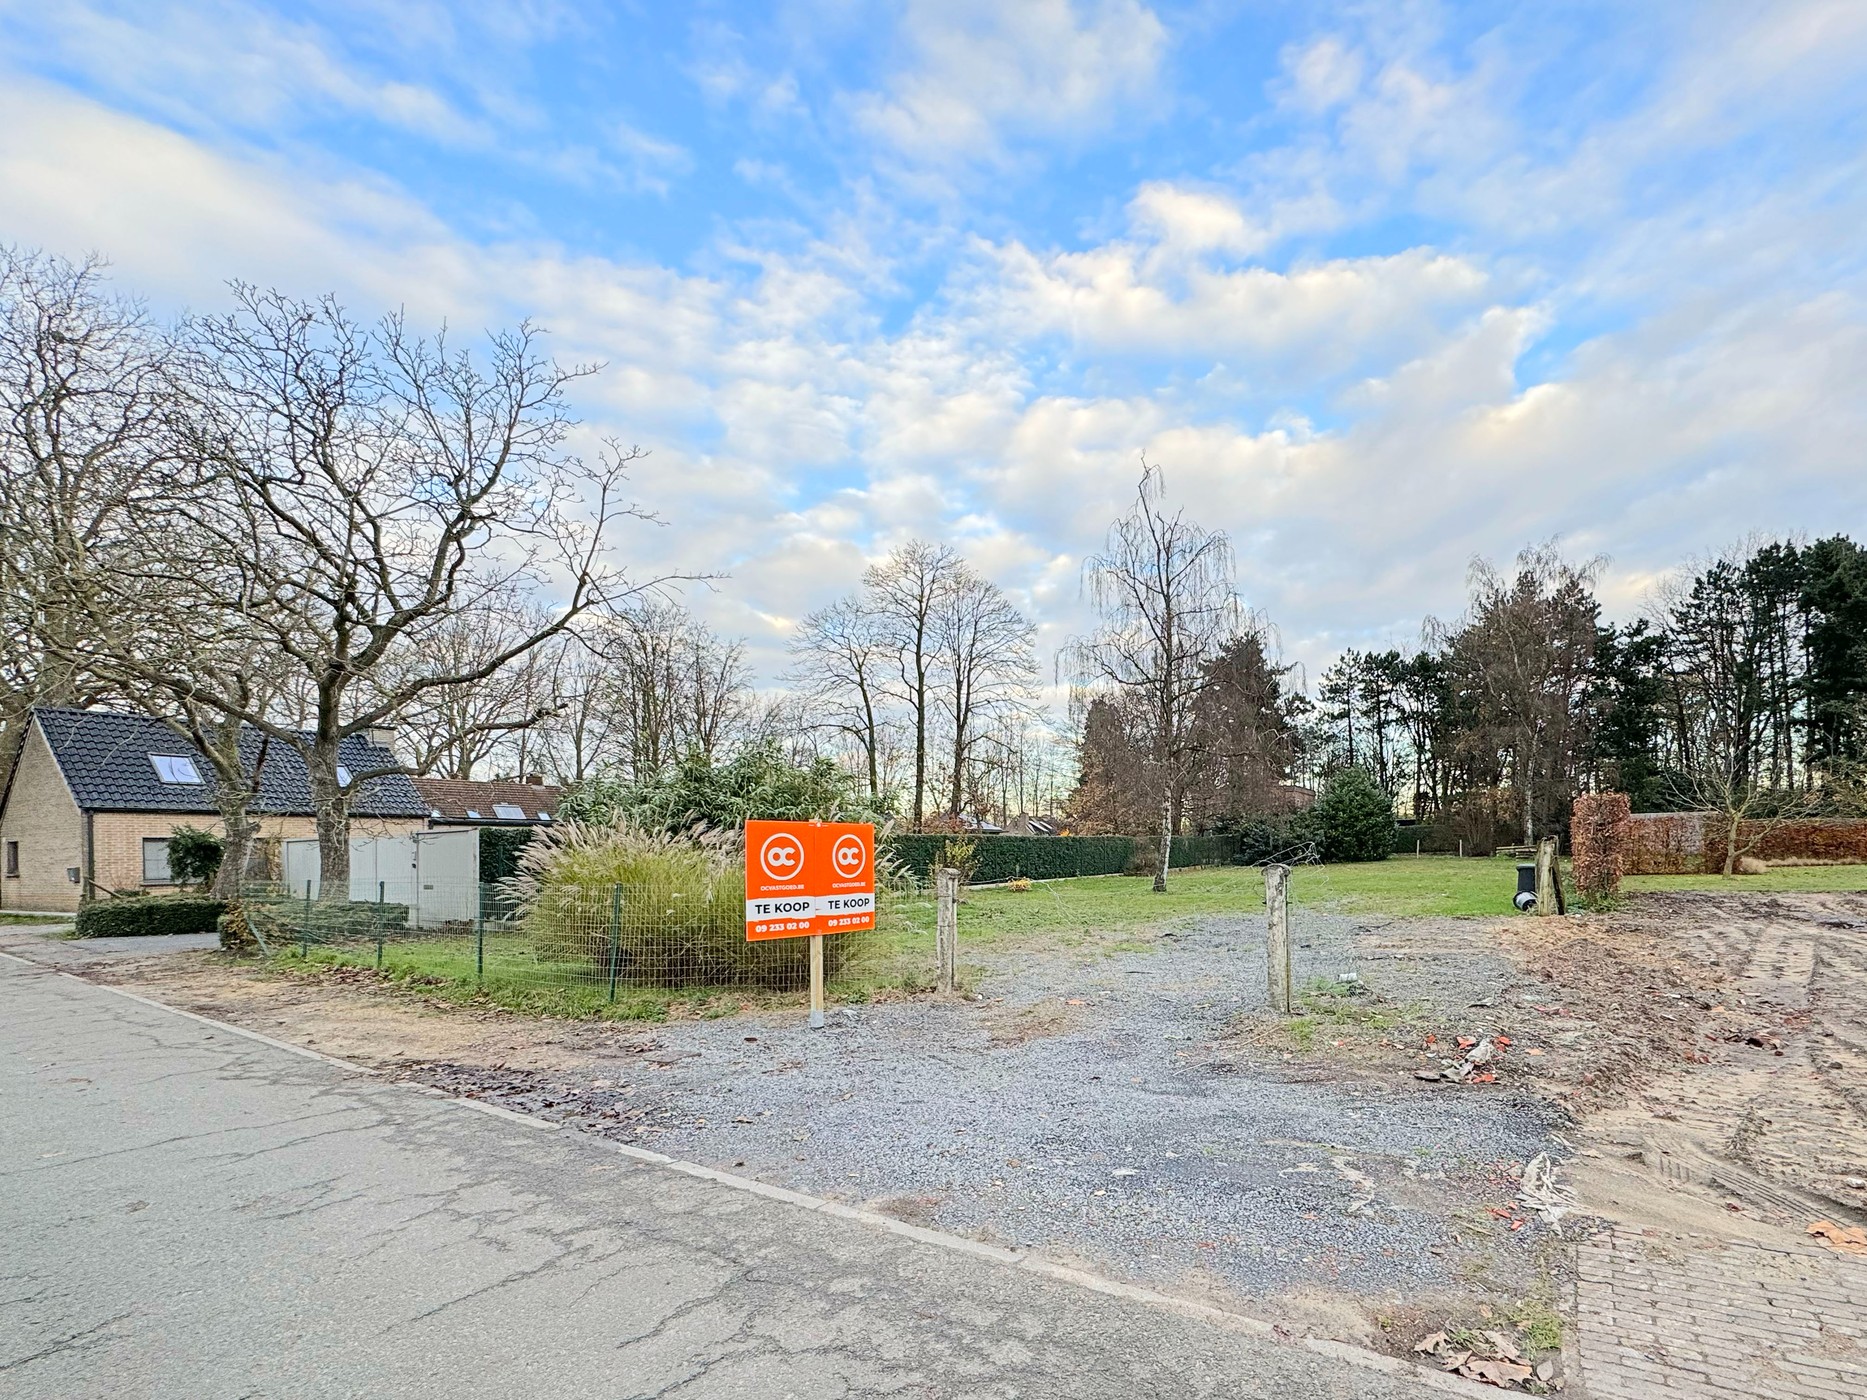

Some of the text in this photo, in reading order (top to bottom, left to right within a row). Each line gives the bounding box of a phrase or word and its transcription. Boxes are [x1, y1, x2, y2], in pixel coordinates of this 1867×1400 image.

[755, 902, 810, 914] TE KOOP
[828, 898, 870, 910] TE KOOP
[755, 921, 810, 933] 09 233 02 00
[828, 919, 838, 927] 09
[839, 918, 851, 926] 233
